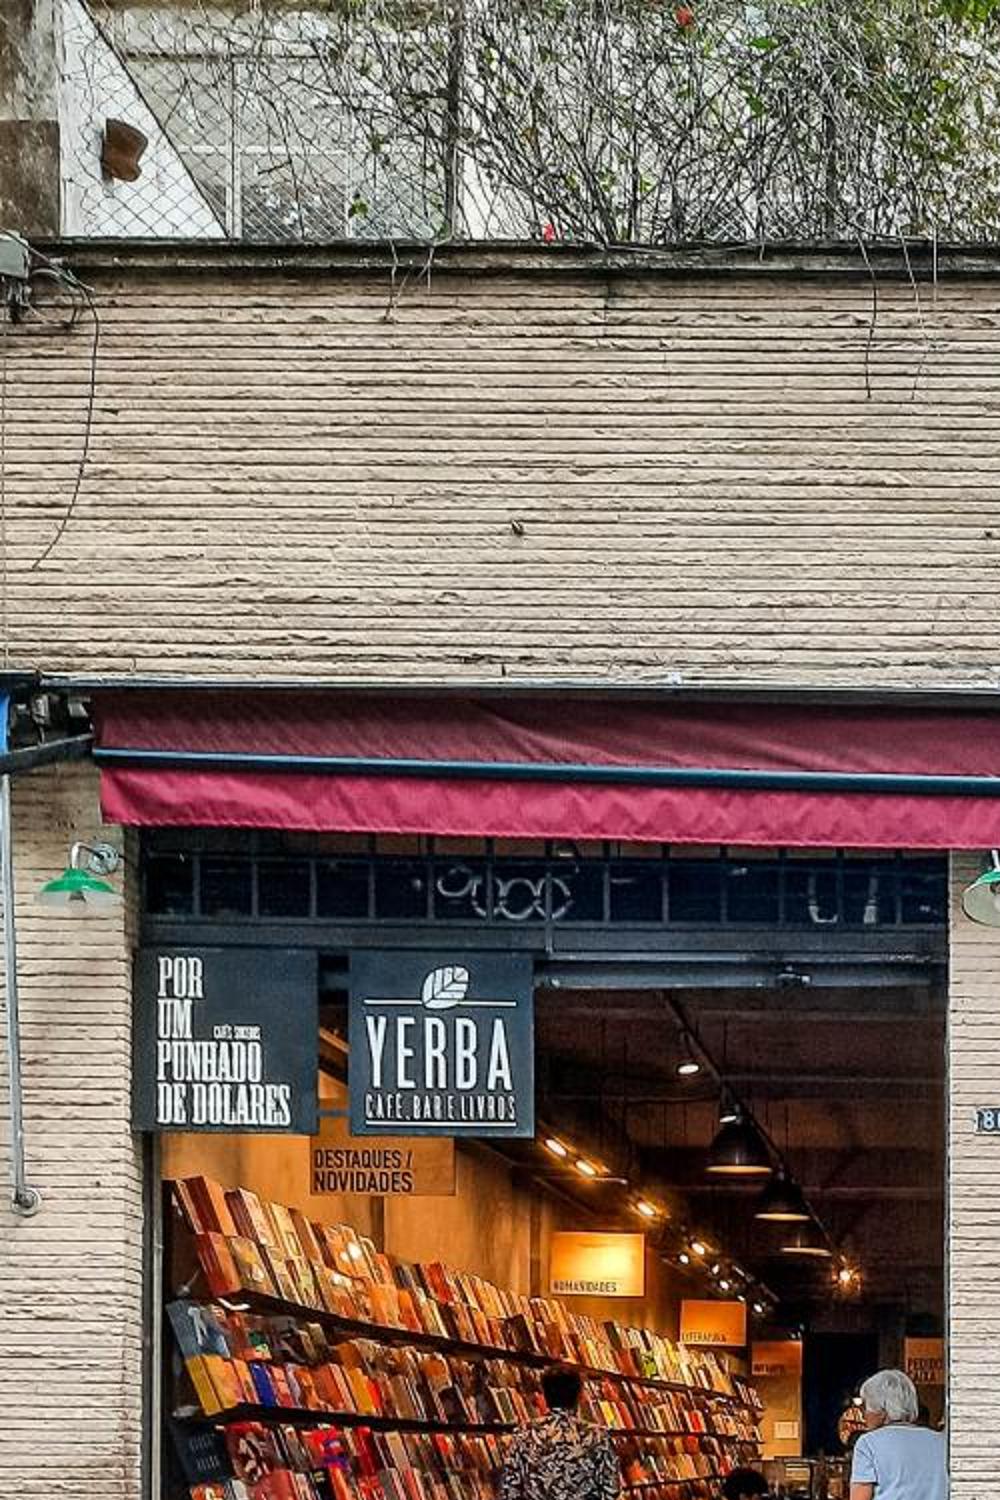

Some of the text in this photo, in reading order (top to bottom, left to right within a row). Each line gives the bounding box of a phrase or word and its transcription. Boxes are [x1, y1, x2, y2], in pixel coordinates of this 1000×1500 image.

[157, 956, 204, 998] POR
[157, 998, 193, 1039] UM
[157, 1040, 263, 1082] PUNHADO
[365, 1015, 513, 1091] YERBA
[157, 1082, 187, 1124] DE
[413, 1095, 443, 1120] BAR
[447, 1095, 454, 1120] E
[460, 1095, 516, 1120] LIVROS
[314, 1148, 402, 1169] DESTAQUES
[314, 1170, 413, 1193] NOVIDADES
